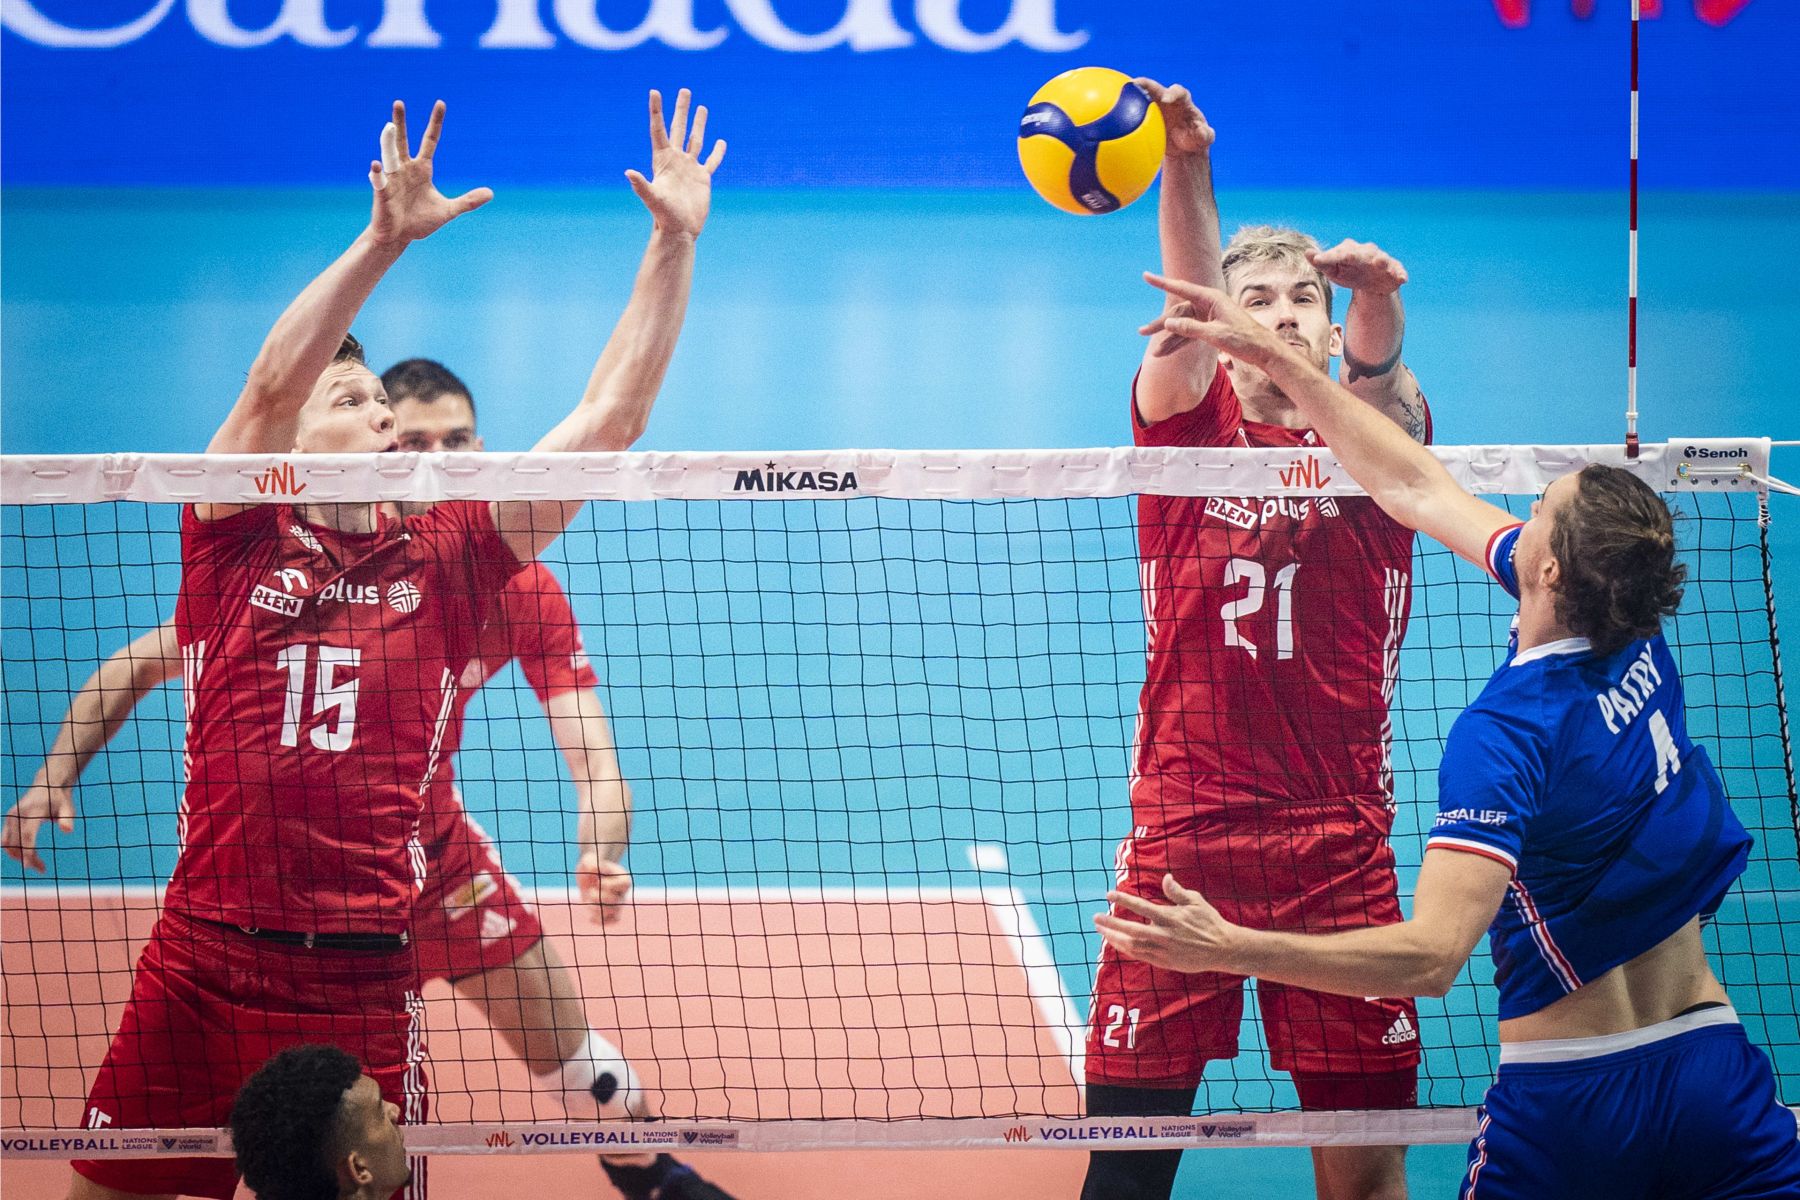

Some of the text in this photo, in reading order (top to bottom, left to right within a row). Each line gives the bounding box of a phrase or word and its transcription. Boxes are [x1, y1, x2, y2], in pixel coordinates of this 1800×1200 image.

[1698, 447, 1748, 458] Senoh
[733, 461, 858, 492] MIKASA
[316, 578, 380, 606] plus
[1220, 558, 1302, 660] 21
[276, 643, 362, 752] 15
[1596, 641, 1662, 735] PATRY
[1103, 1004, 1140, 1049] 21
[1, 1138, 119, 1151] VOLLEYBALL
[521, 1132, 640, 1145] VOLLEYBALL
[1040, 1126, 1158, 1140] VOLLEYBALL
